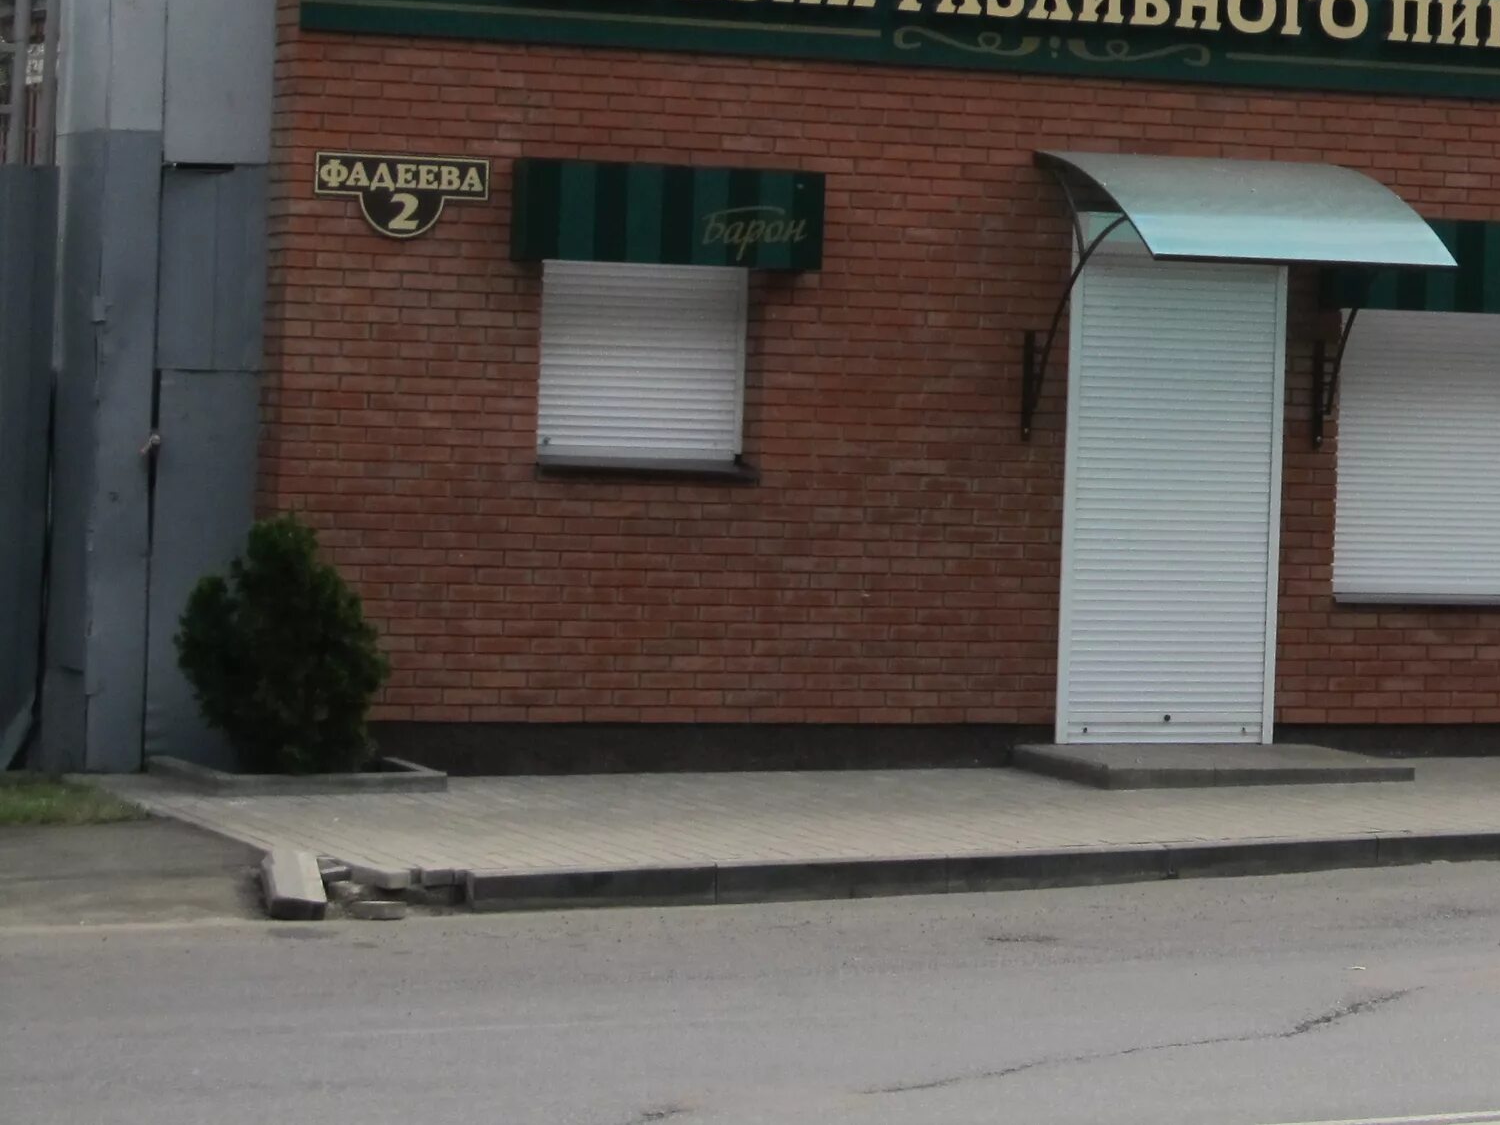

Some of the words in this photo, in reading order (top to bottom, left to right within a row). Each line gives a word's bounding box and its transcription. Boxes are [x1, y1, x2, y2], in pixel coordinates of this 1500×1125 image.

[319, 159, 484, 192] ФАДЕЕВА
[388, 192, 420, 230] 2
[702, 205, 808, 261] Барон
